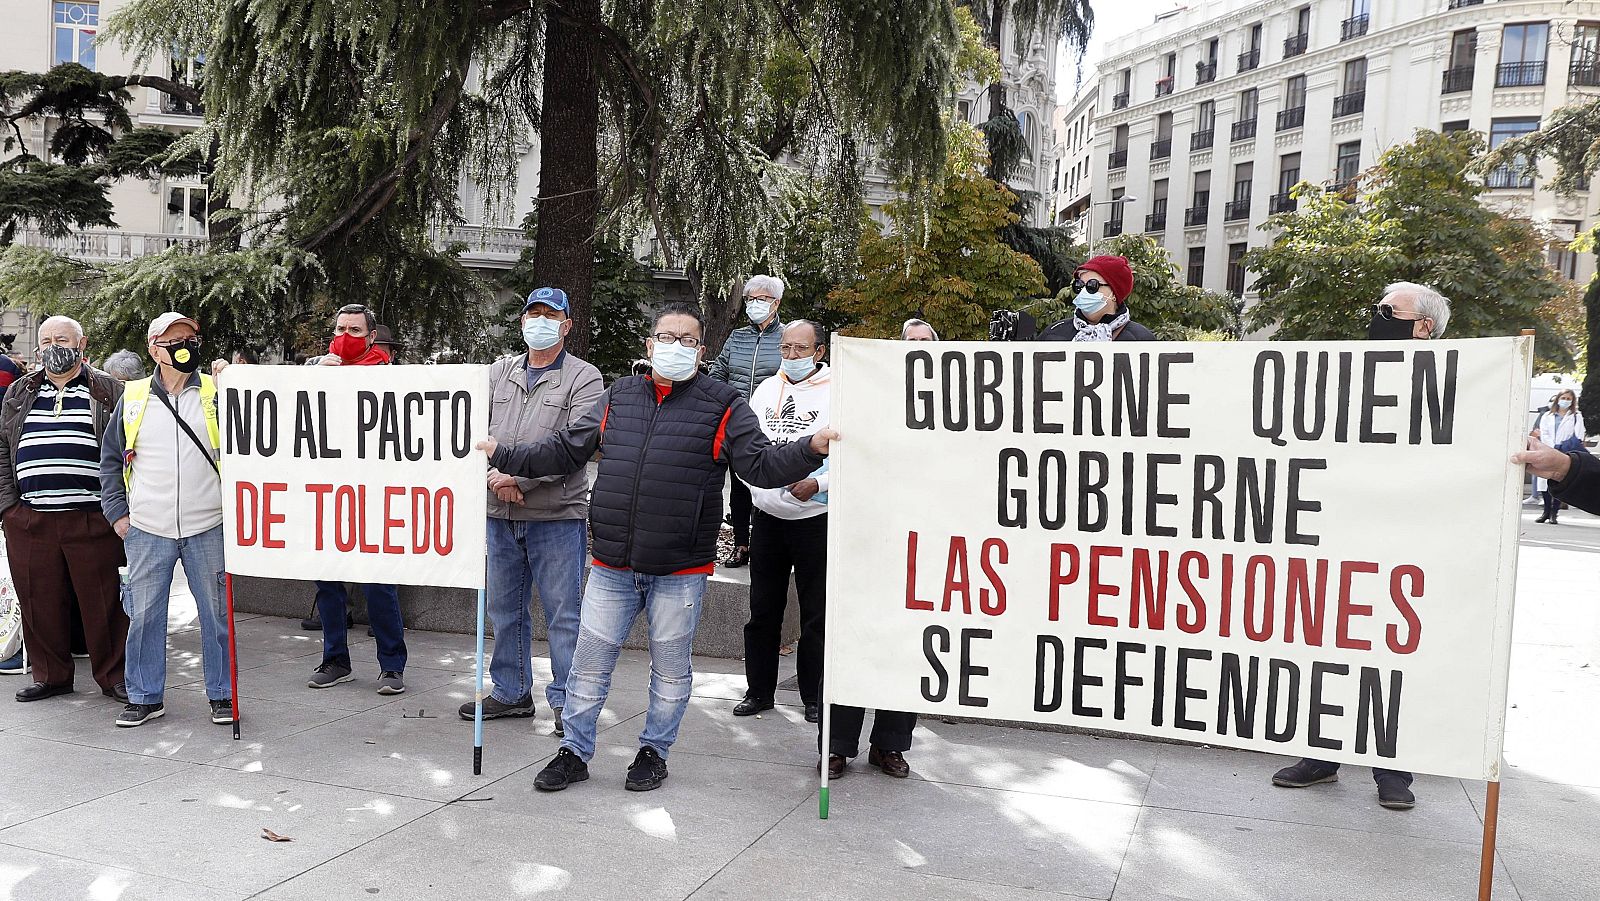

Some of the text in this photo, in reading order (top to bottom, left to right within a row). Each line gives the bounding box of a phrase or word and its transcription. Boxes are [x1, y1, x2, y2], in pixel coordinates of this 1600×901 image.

[226, 387, 472, 462] NO AL PACTO
[905, 349, 1459, 447] GOBIERNE QUIEN
[235, 480, 454, 557] DE TOLEDO
[997, 447, 1328, 547] GOBIERNE
[906, 531, 1424, 654] LAS PENSIONES
[920, 624, 1403, 759] SE DEFIENDEN
